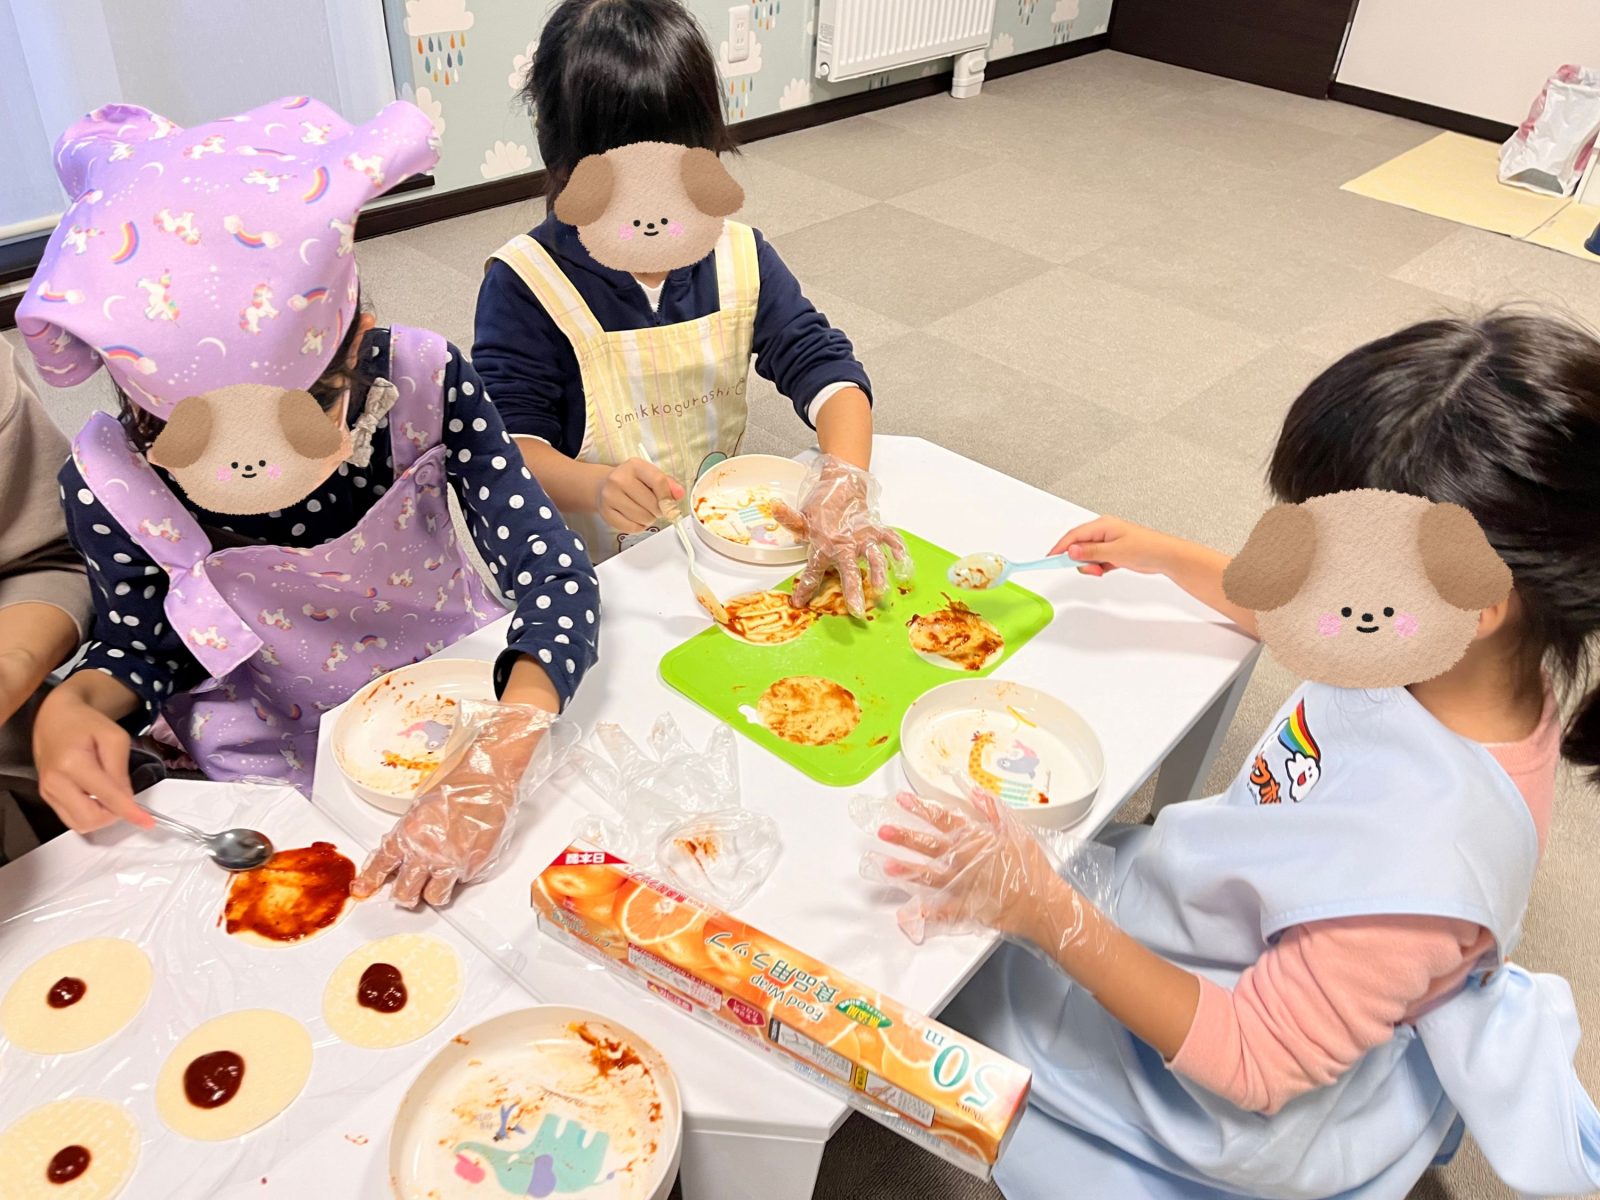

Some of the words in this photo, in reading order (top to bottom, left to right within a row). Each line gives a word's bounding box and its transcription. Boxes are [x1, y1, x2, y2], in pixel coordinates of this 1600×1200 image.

[706, 933, 840, 1004] 食品用ラップ
[751, 975, 786, 1002] Wrap
[786, 995, 824, 1023] Food
